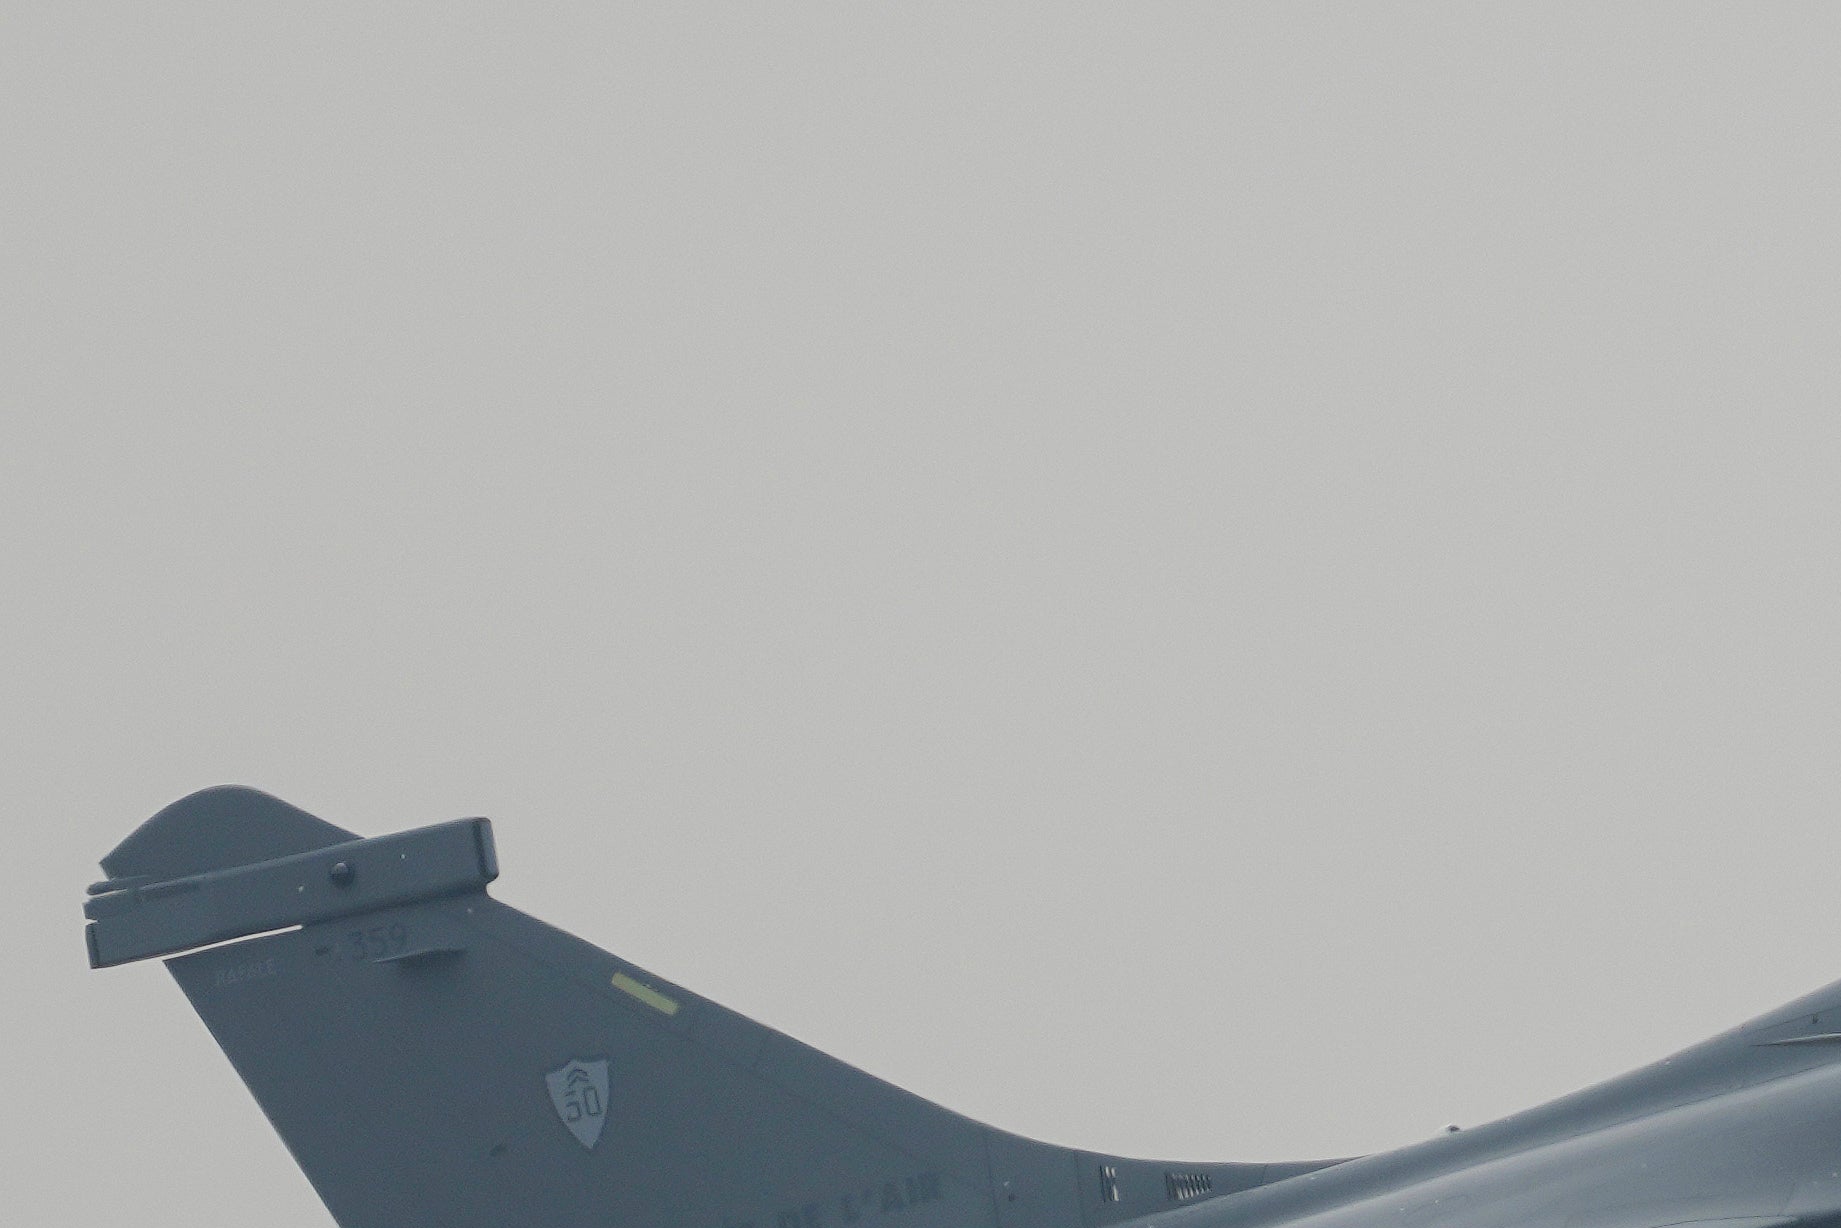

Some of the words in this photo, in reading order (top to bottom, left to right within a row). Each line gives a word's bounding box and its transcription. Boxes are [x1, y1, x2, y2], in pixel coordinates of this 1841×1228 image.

[348, 923, 407, 961] 359
[565, 1086, 602, 1121] 50
[840, 1171, 944, 1224] L'AIR
